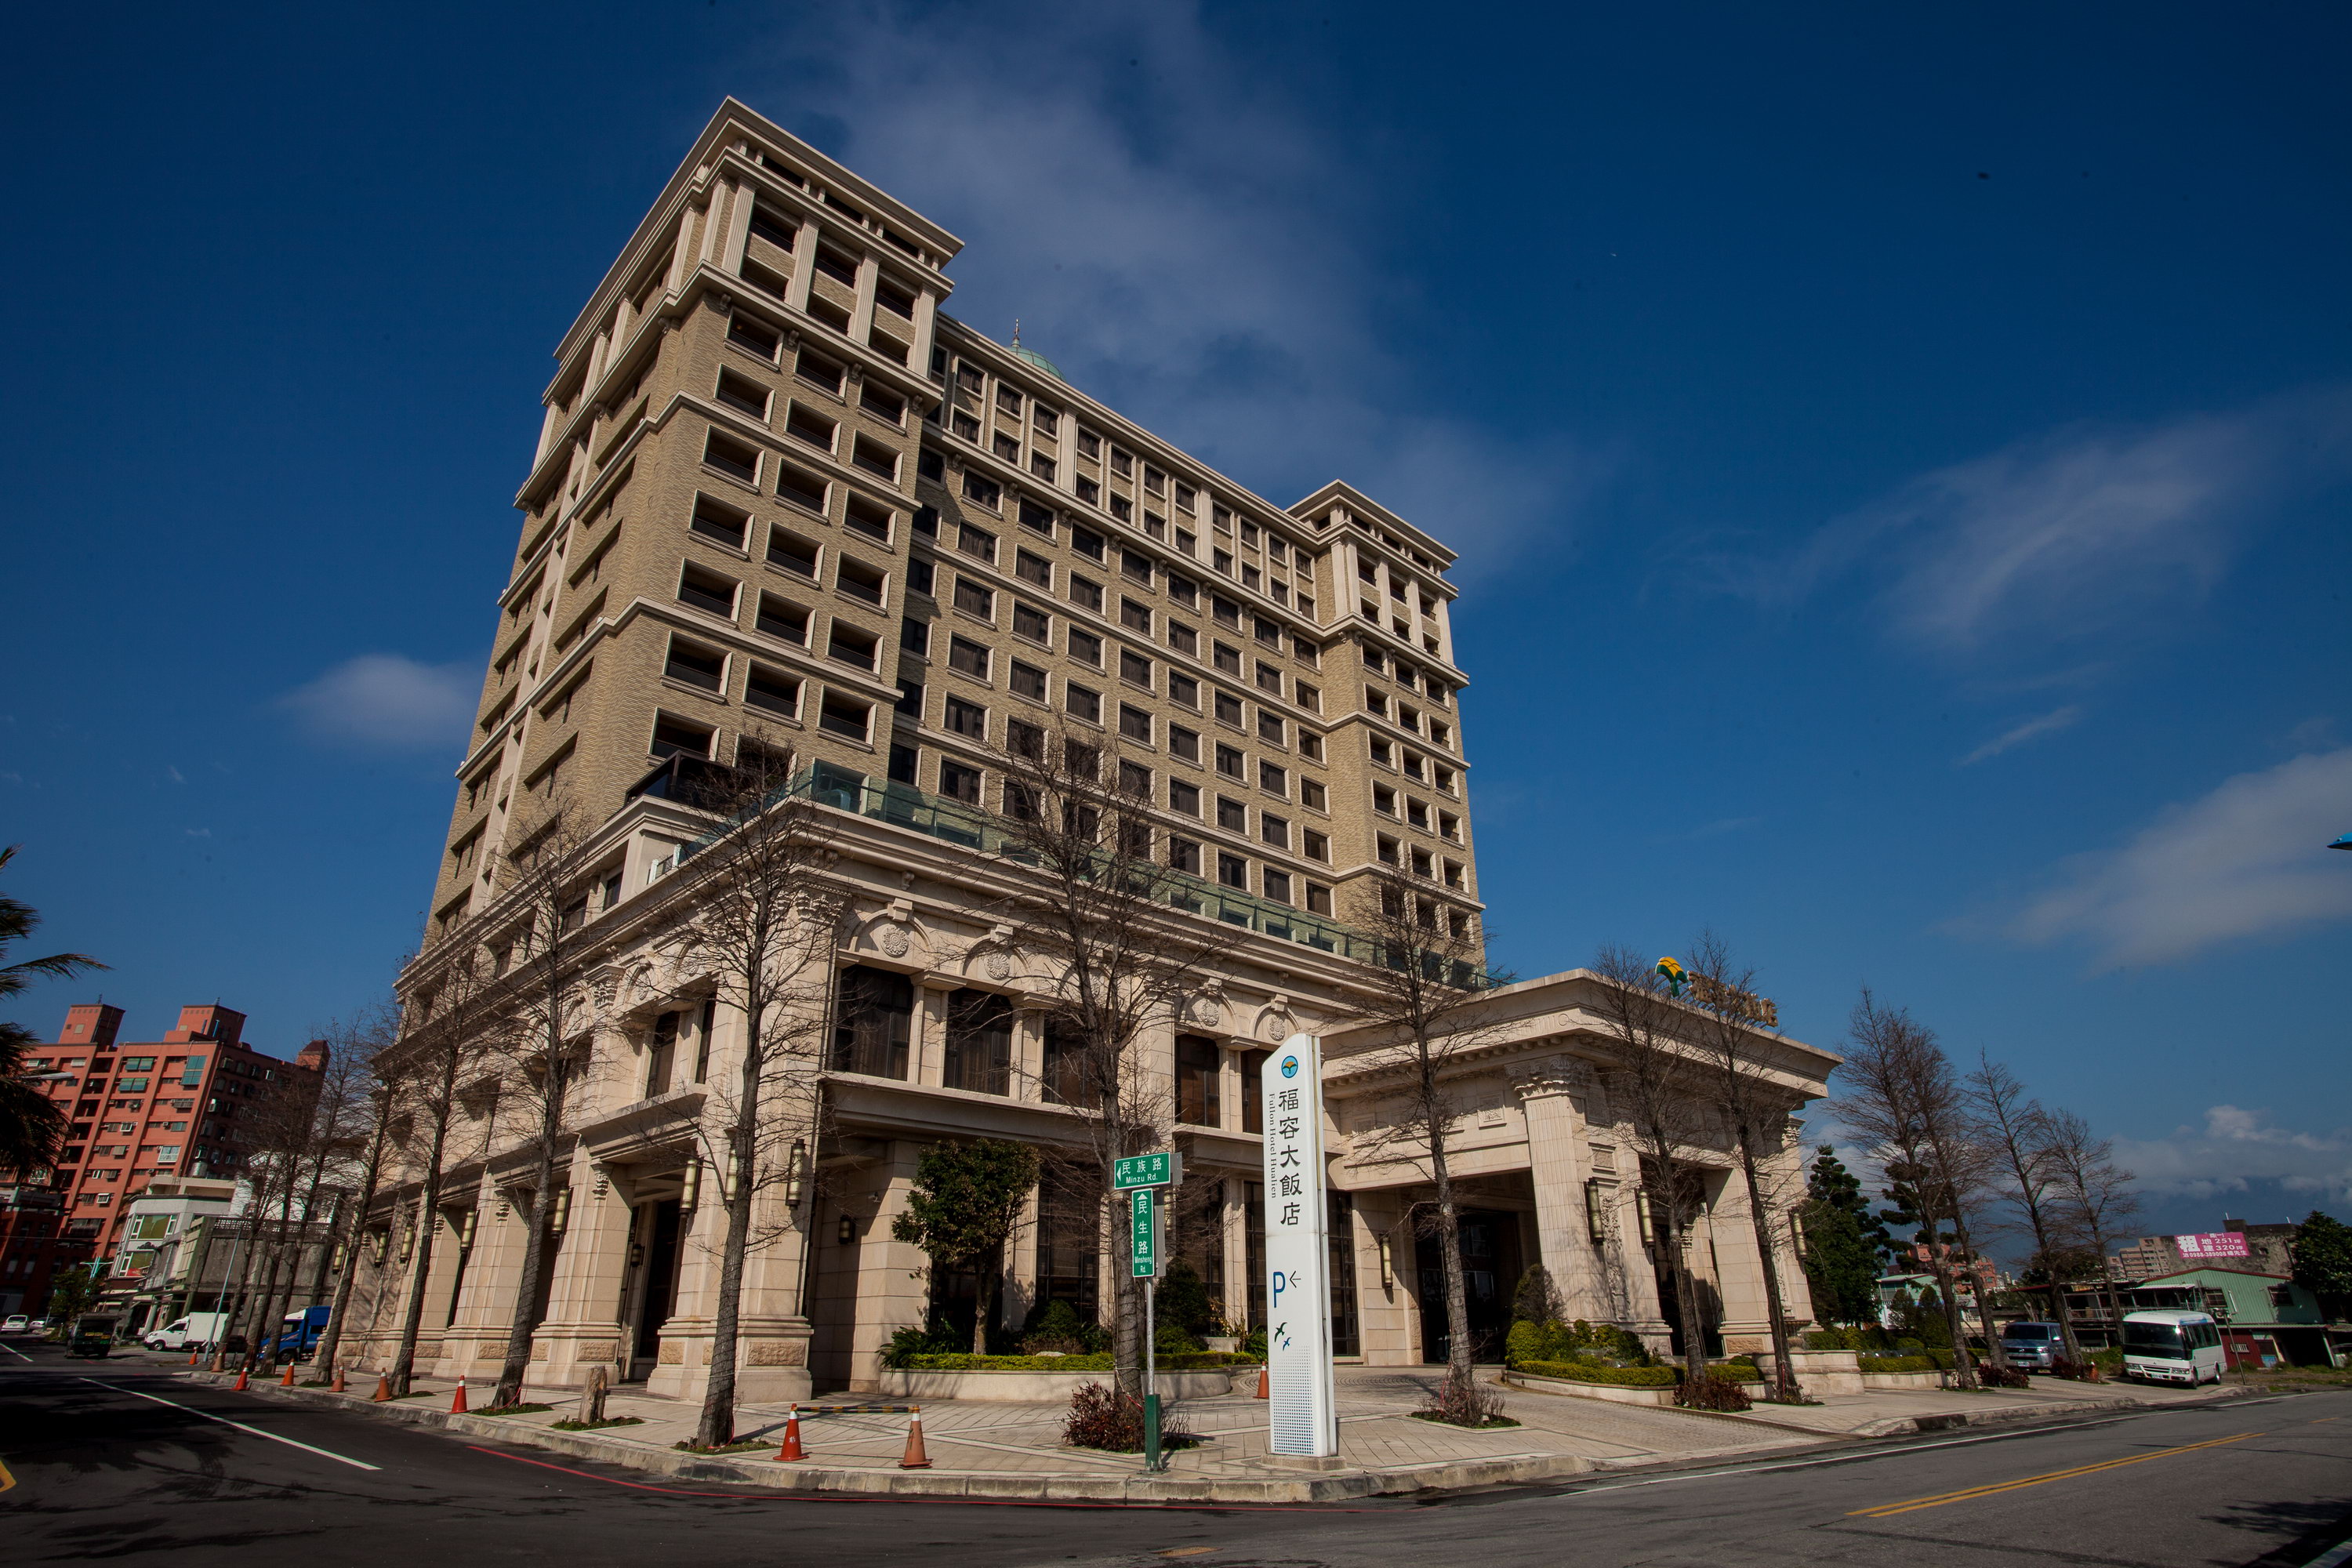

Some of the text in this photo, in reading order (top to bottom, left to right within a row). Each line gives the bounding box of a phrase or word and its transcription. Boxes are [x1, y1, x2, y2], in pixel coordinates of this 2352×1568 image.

[1122, 1157, 1162, 1174] 民族路
[1279, 1088, 1303, 1225] 福容大飯店
[1138, 1201, 1148, 1254] 民生路
[2177, 1236, 2200, 1252] 租
[1134, 1256, 1152, 1265] Minsheng
[1273, 1272, 1286, 1308] P
